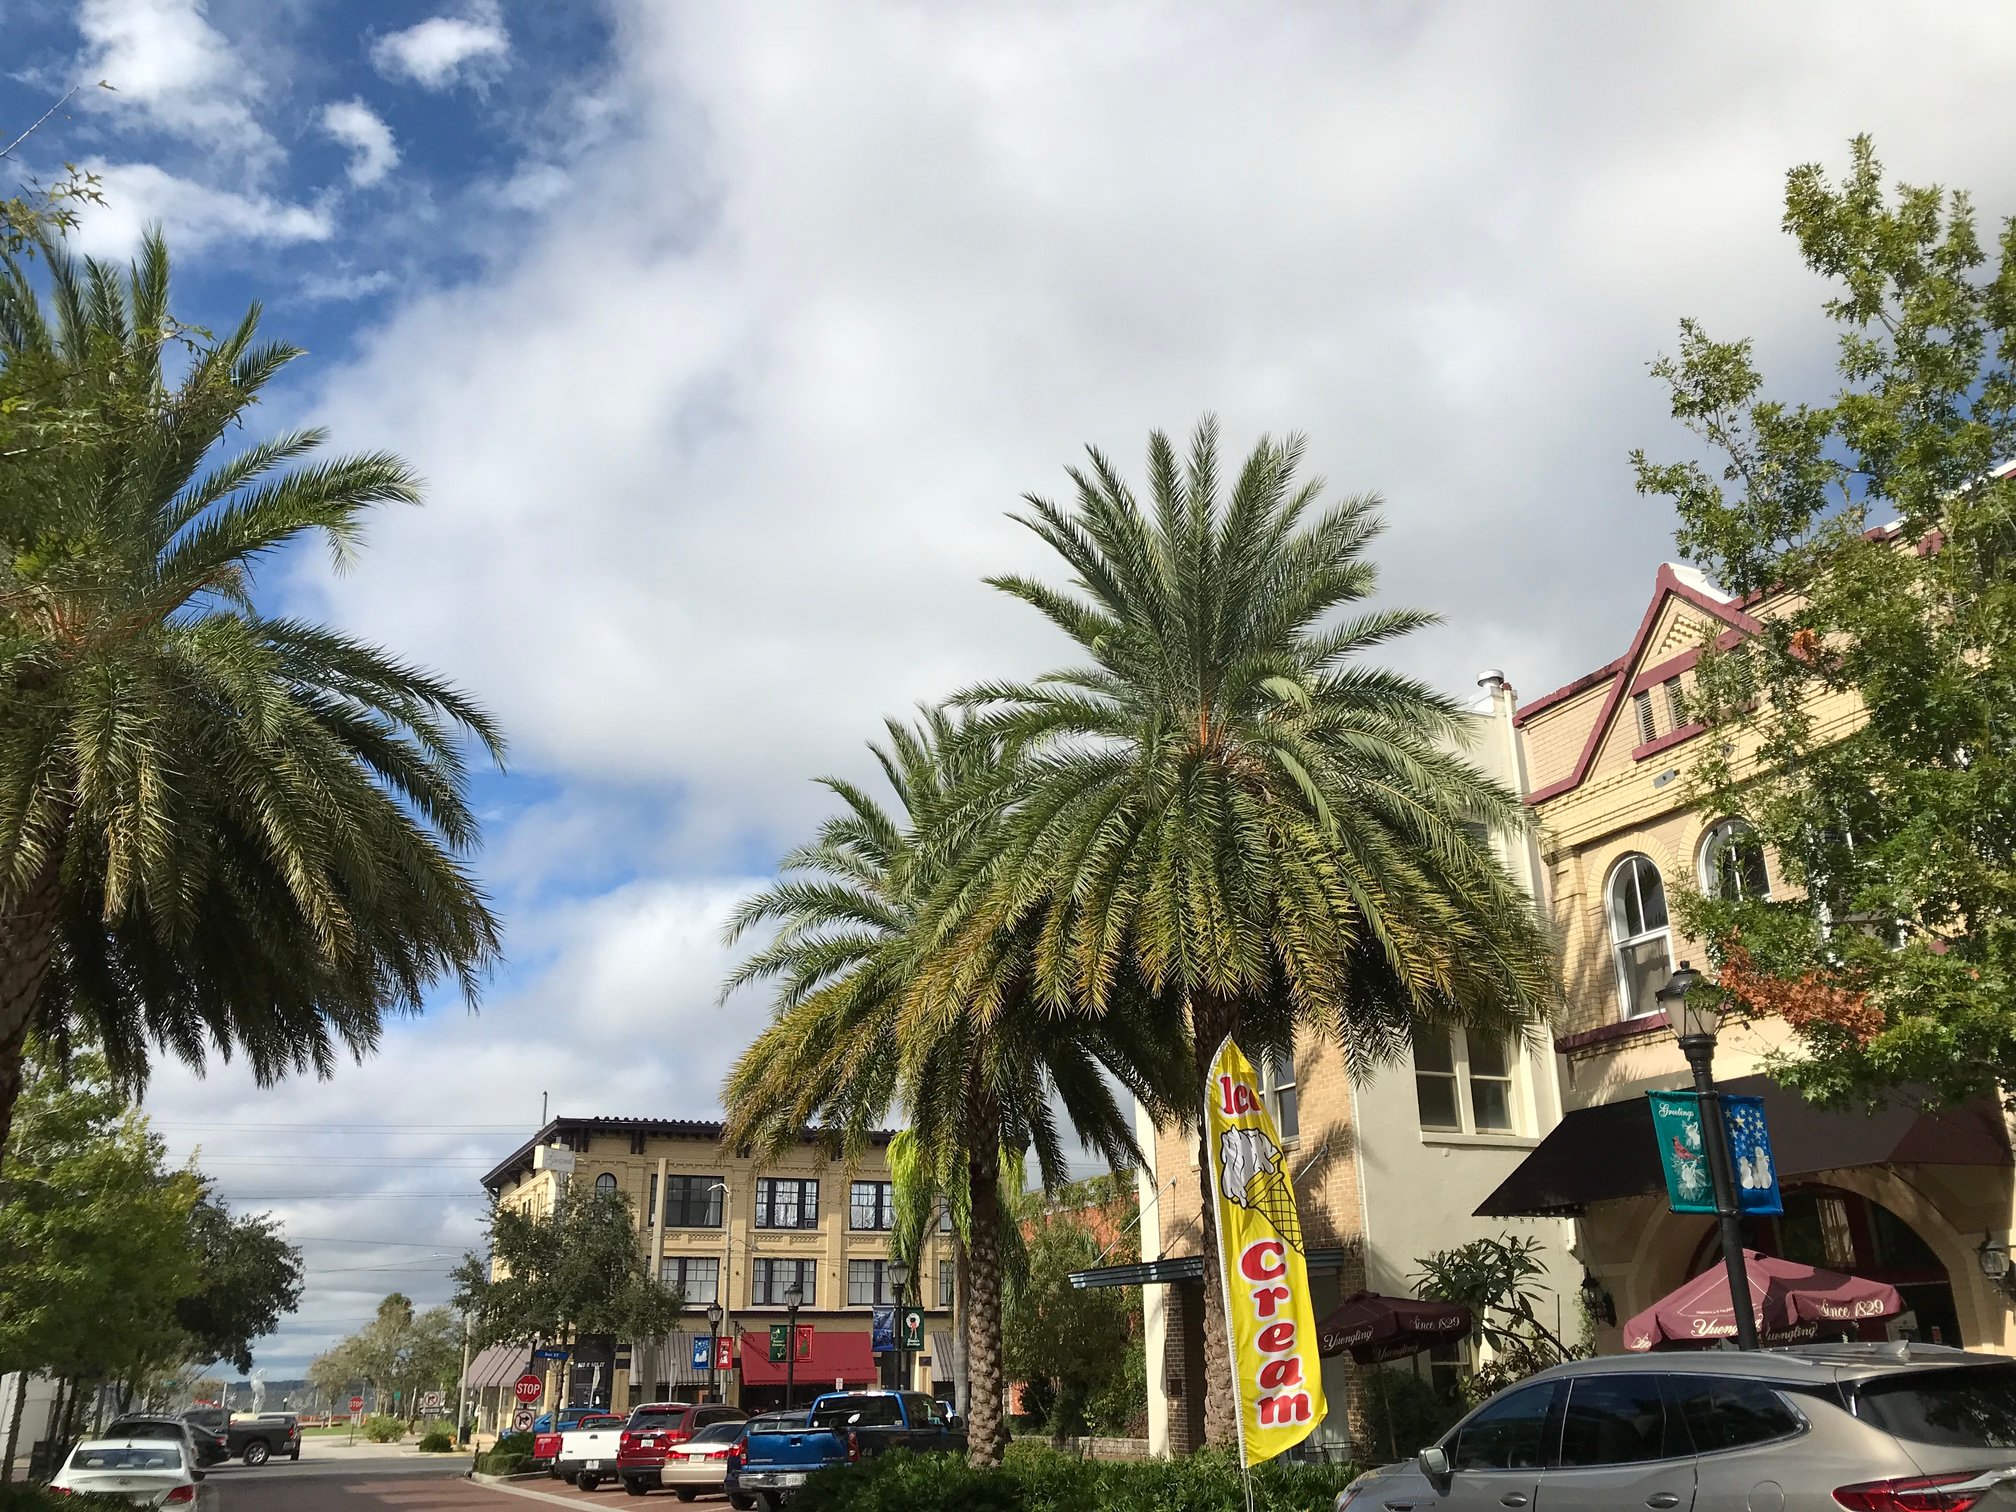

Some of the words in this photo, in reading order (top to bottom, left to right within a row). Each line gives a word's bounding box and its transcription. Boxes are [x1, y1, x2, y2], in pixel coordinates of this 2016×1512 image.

[1659, 1103, 1694, 1121] Greetings
[1816, 1299, 1850, 1317] Since
[1855, 1300, 1884, 1317] 1829
[1410, 1316, 1435, 1330] Since
[1438, 1317, 1460, 1329] 1829
[1324, 1325, 1374, 1350] Yuengling
[516, 1383, 540, 1395] STOP
